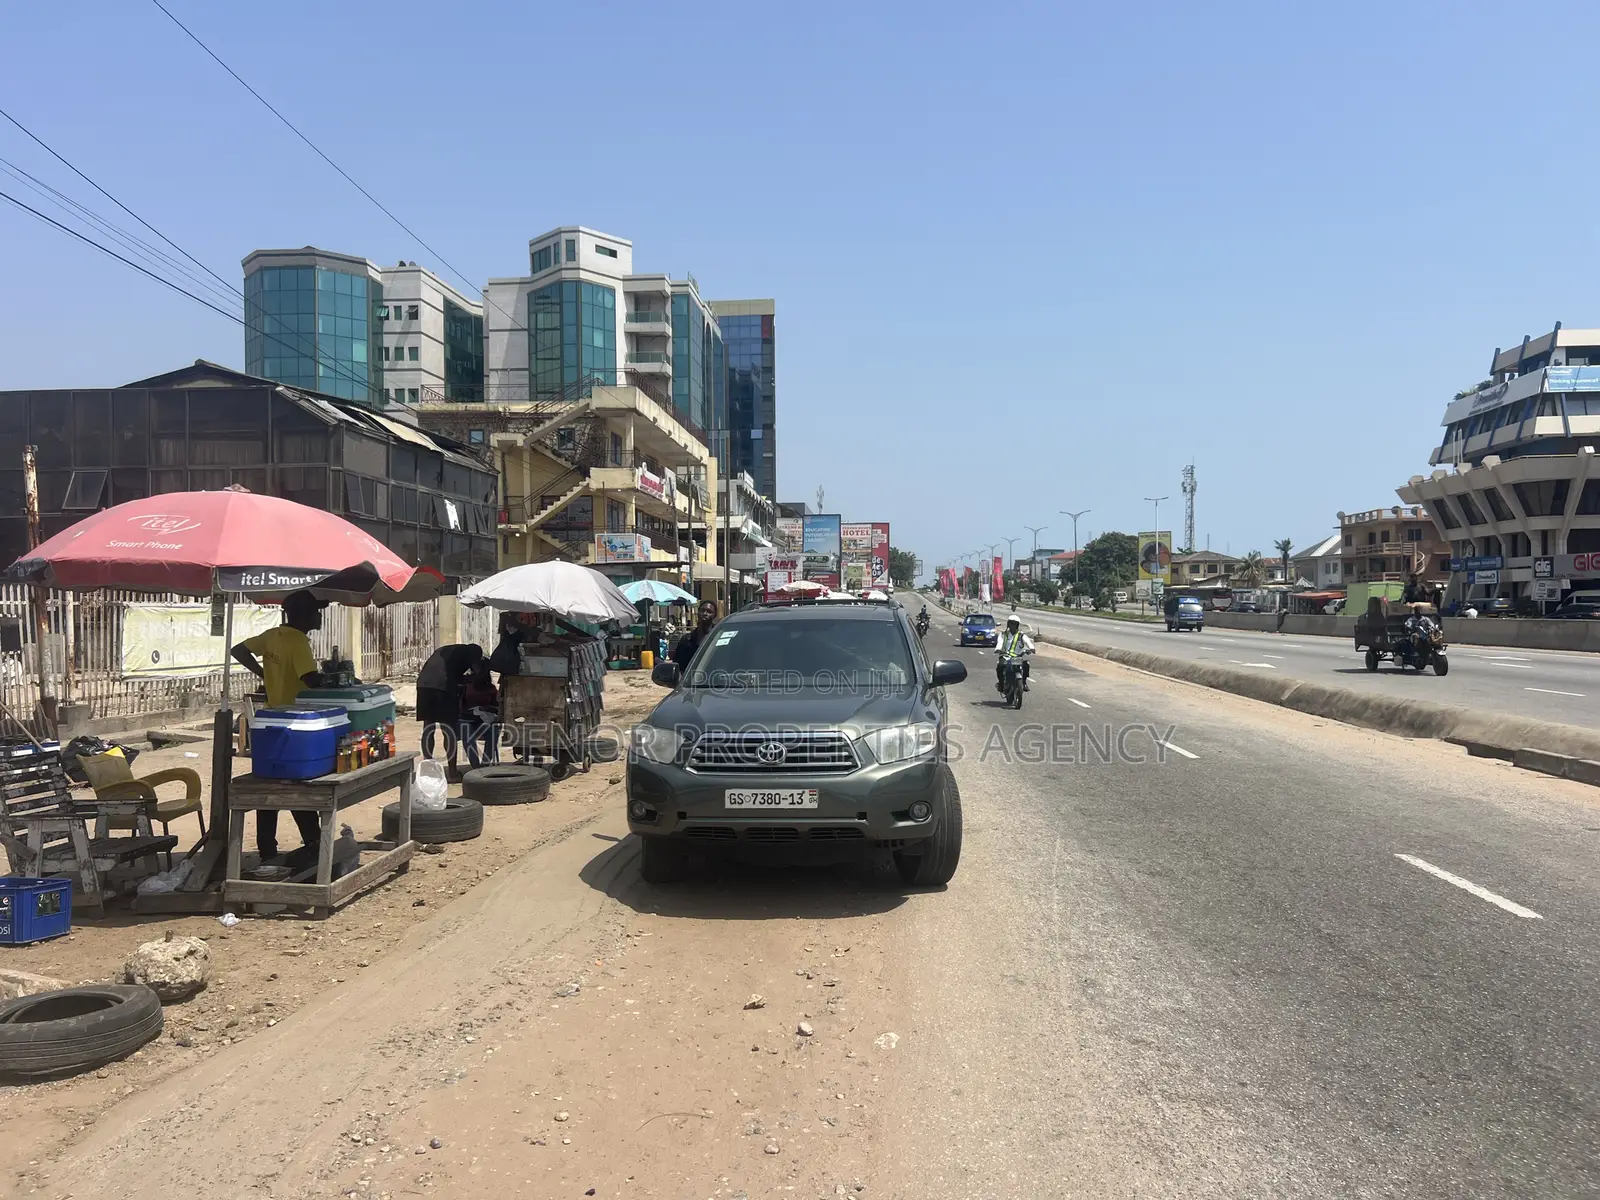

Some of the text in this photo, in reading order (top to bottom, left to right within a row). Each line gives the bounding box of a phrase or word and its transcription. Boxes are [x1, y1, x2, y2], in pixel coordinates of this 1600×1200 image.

[142, 517, 190, 528] itel
[106, 540, 184, 550] Smart Phone
[241, 572, 265, 586] itel
[268, 572, 312, 586] Smart
[729, 793, 744, 805] GS
